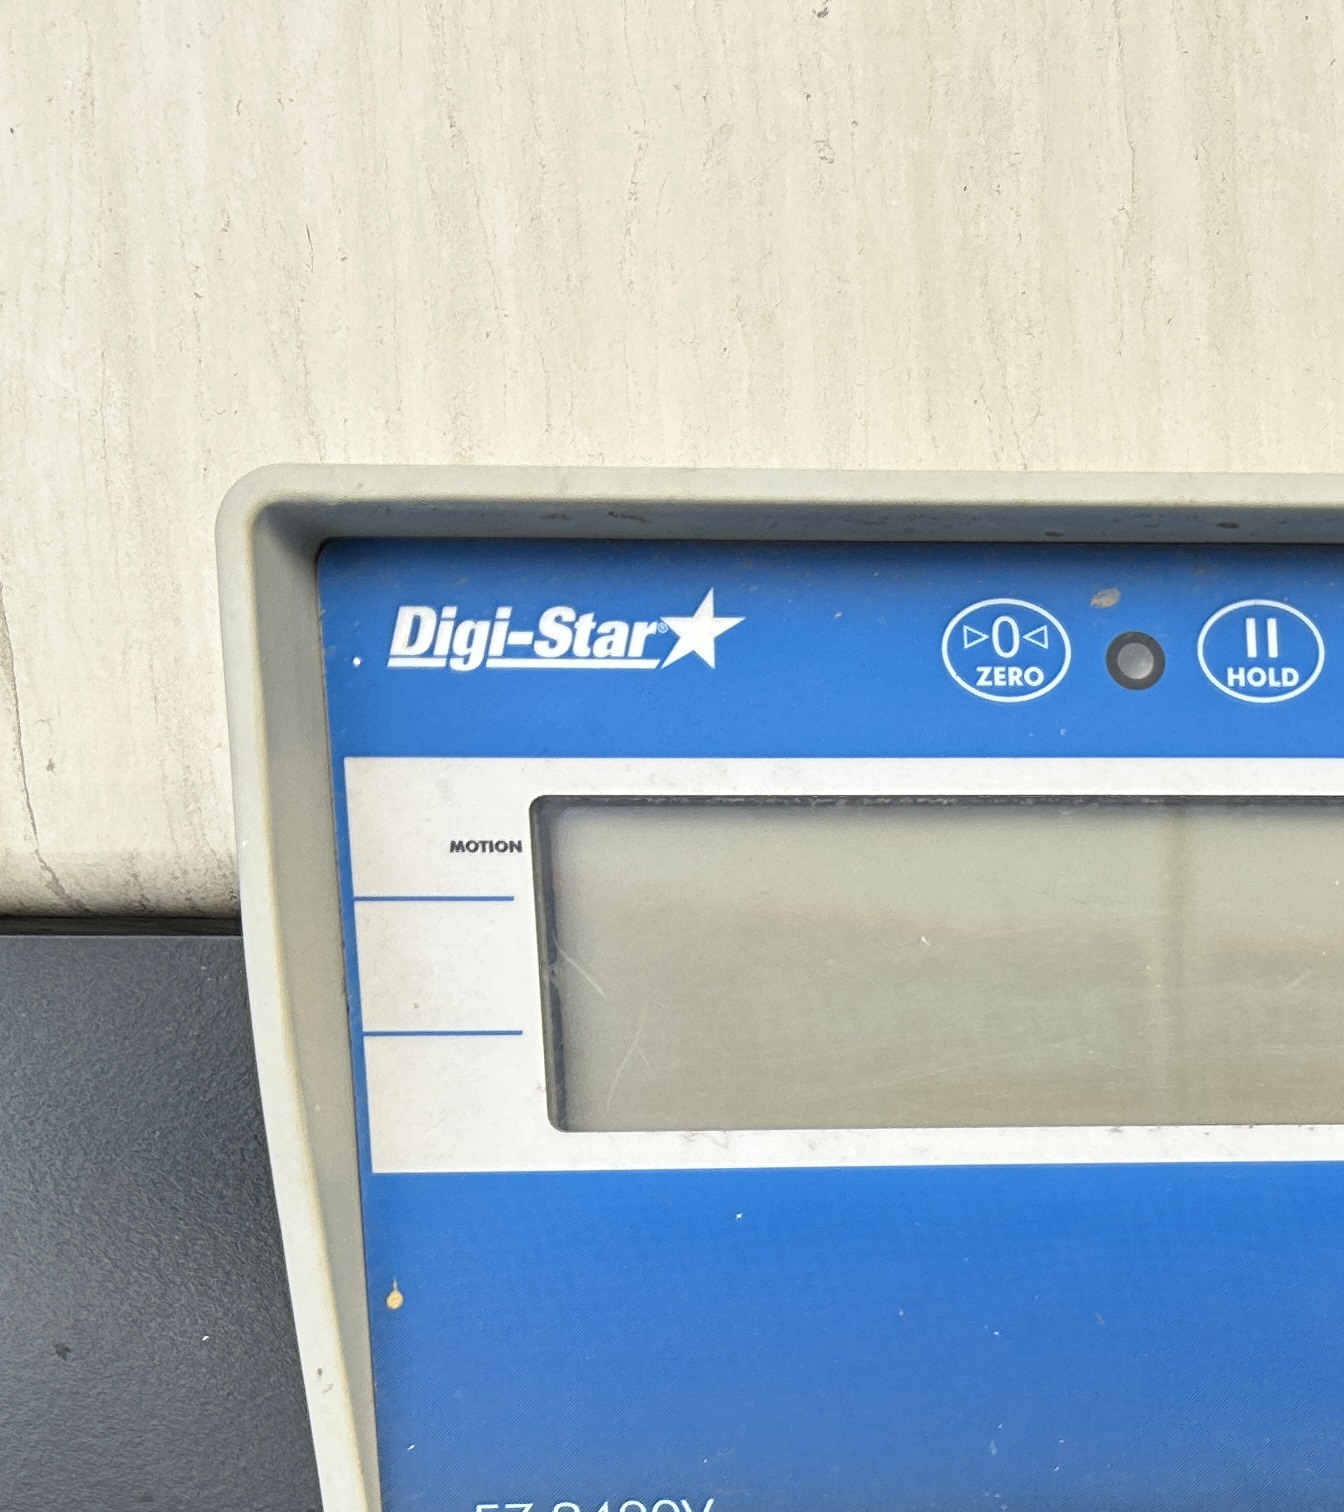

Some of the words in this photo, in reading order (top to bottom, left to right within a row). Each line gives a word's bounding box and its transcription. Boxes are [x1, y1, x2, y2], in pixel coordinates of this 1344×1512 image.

[388, 604, 662, 671] Digi-Star
[976, 666, 1045, 687] ZERO
[1227, 666, 1299, 688] HOLD
[449, 838, 523, 855] MOTION
